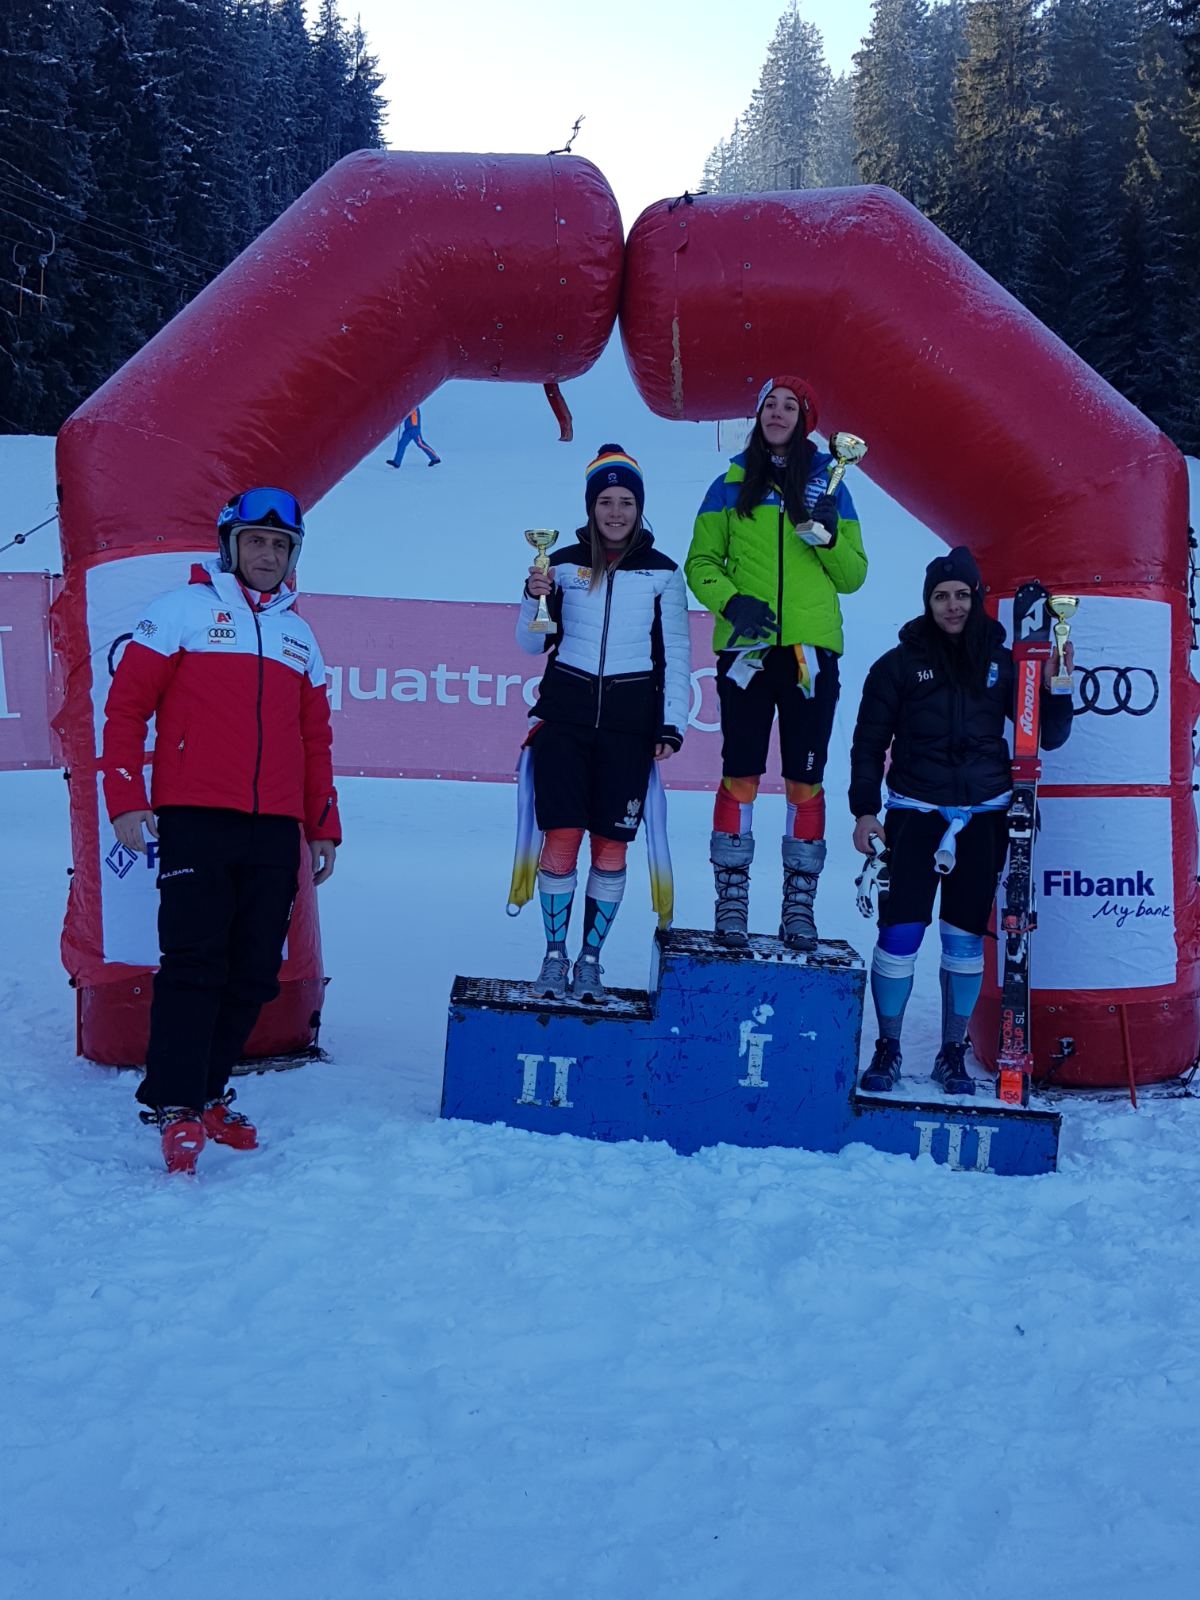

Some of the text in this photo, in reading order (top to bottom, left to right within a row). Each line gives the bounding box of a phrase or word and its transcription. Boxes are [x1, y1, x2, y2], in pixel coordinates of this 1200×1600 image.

[916, 669, 934, 682] 361
[1020, 660, 1037, 737] NORDICA
[1043, 870, 1155, 897] Fibank
[1092, 899, 1172, 928] My bank
[1015, 1011, 1025, 1025] SL
[1003, 1090, 1019, 1100] 156
